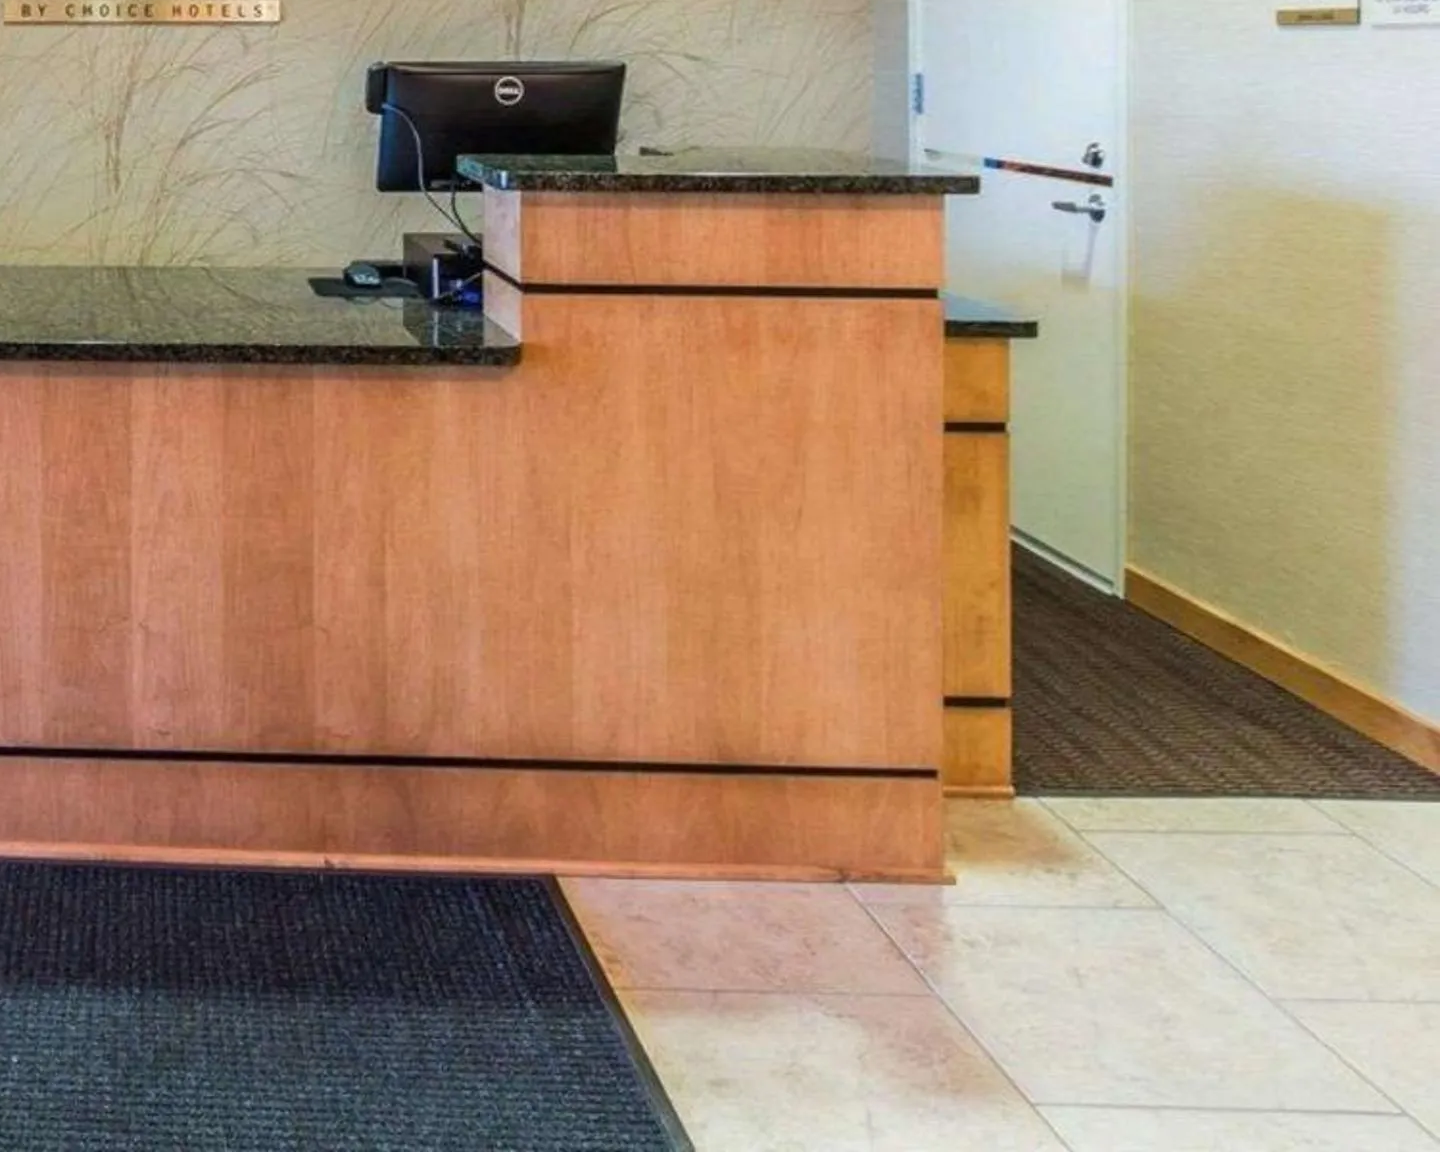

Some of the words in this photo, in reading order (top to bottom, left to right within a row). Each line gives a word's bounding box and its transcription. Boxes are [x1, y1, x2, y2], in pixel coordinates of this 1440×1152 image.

[20, 3, 48, 18] BY
[65, 3, 154, 18] CHOICE
[171, 3, 264, 18] HOTELS
